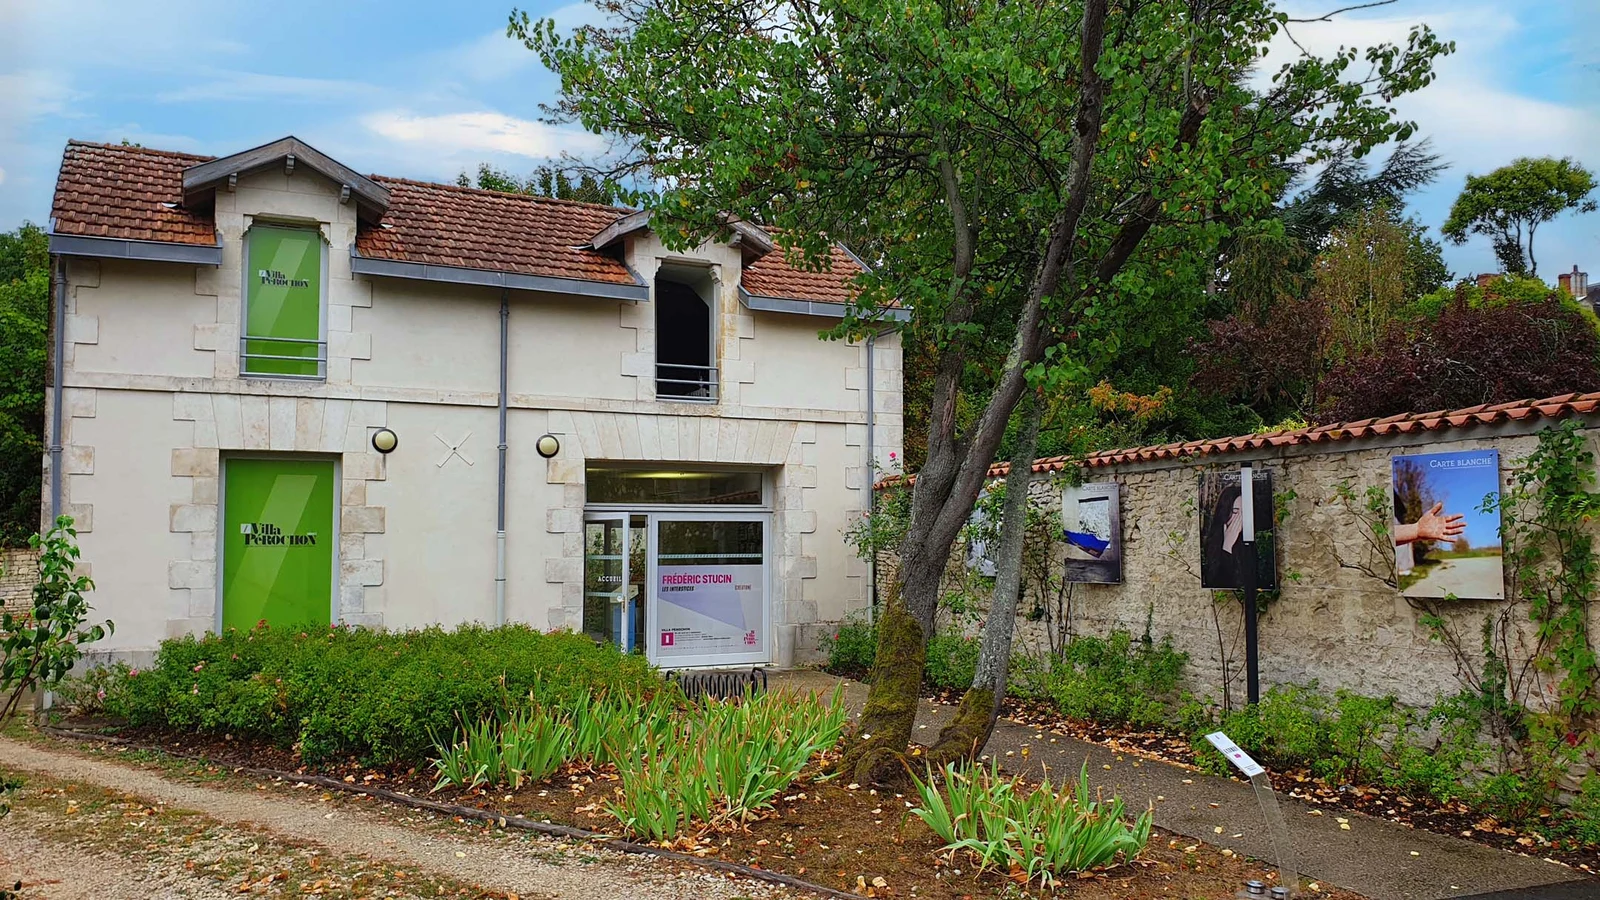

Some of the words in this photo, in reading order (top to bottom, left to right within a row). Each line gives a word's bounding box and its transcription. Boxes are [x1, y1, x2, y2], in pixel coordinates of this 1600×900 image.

[265, 269, 286, 279] Villa
[1457, 457, 1492, 466] BLANCHE
[250, 522, 281, 535] Villa
[662, 573, 701, 584] FRÉDÉRIC
[702, 574, 732, 584] STUCIN
